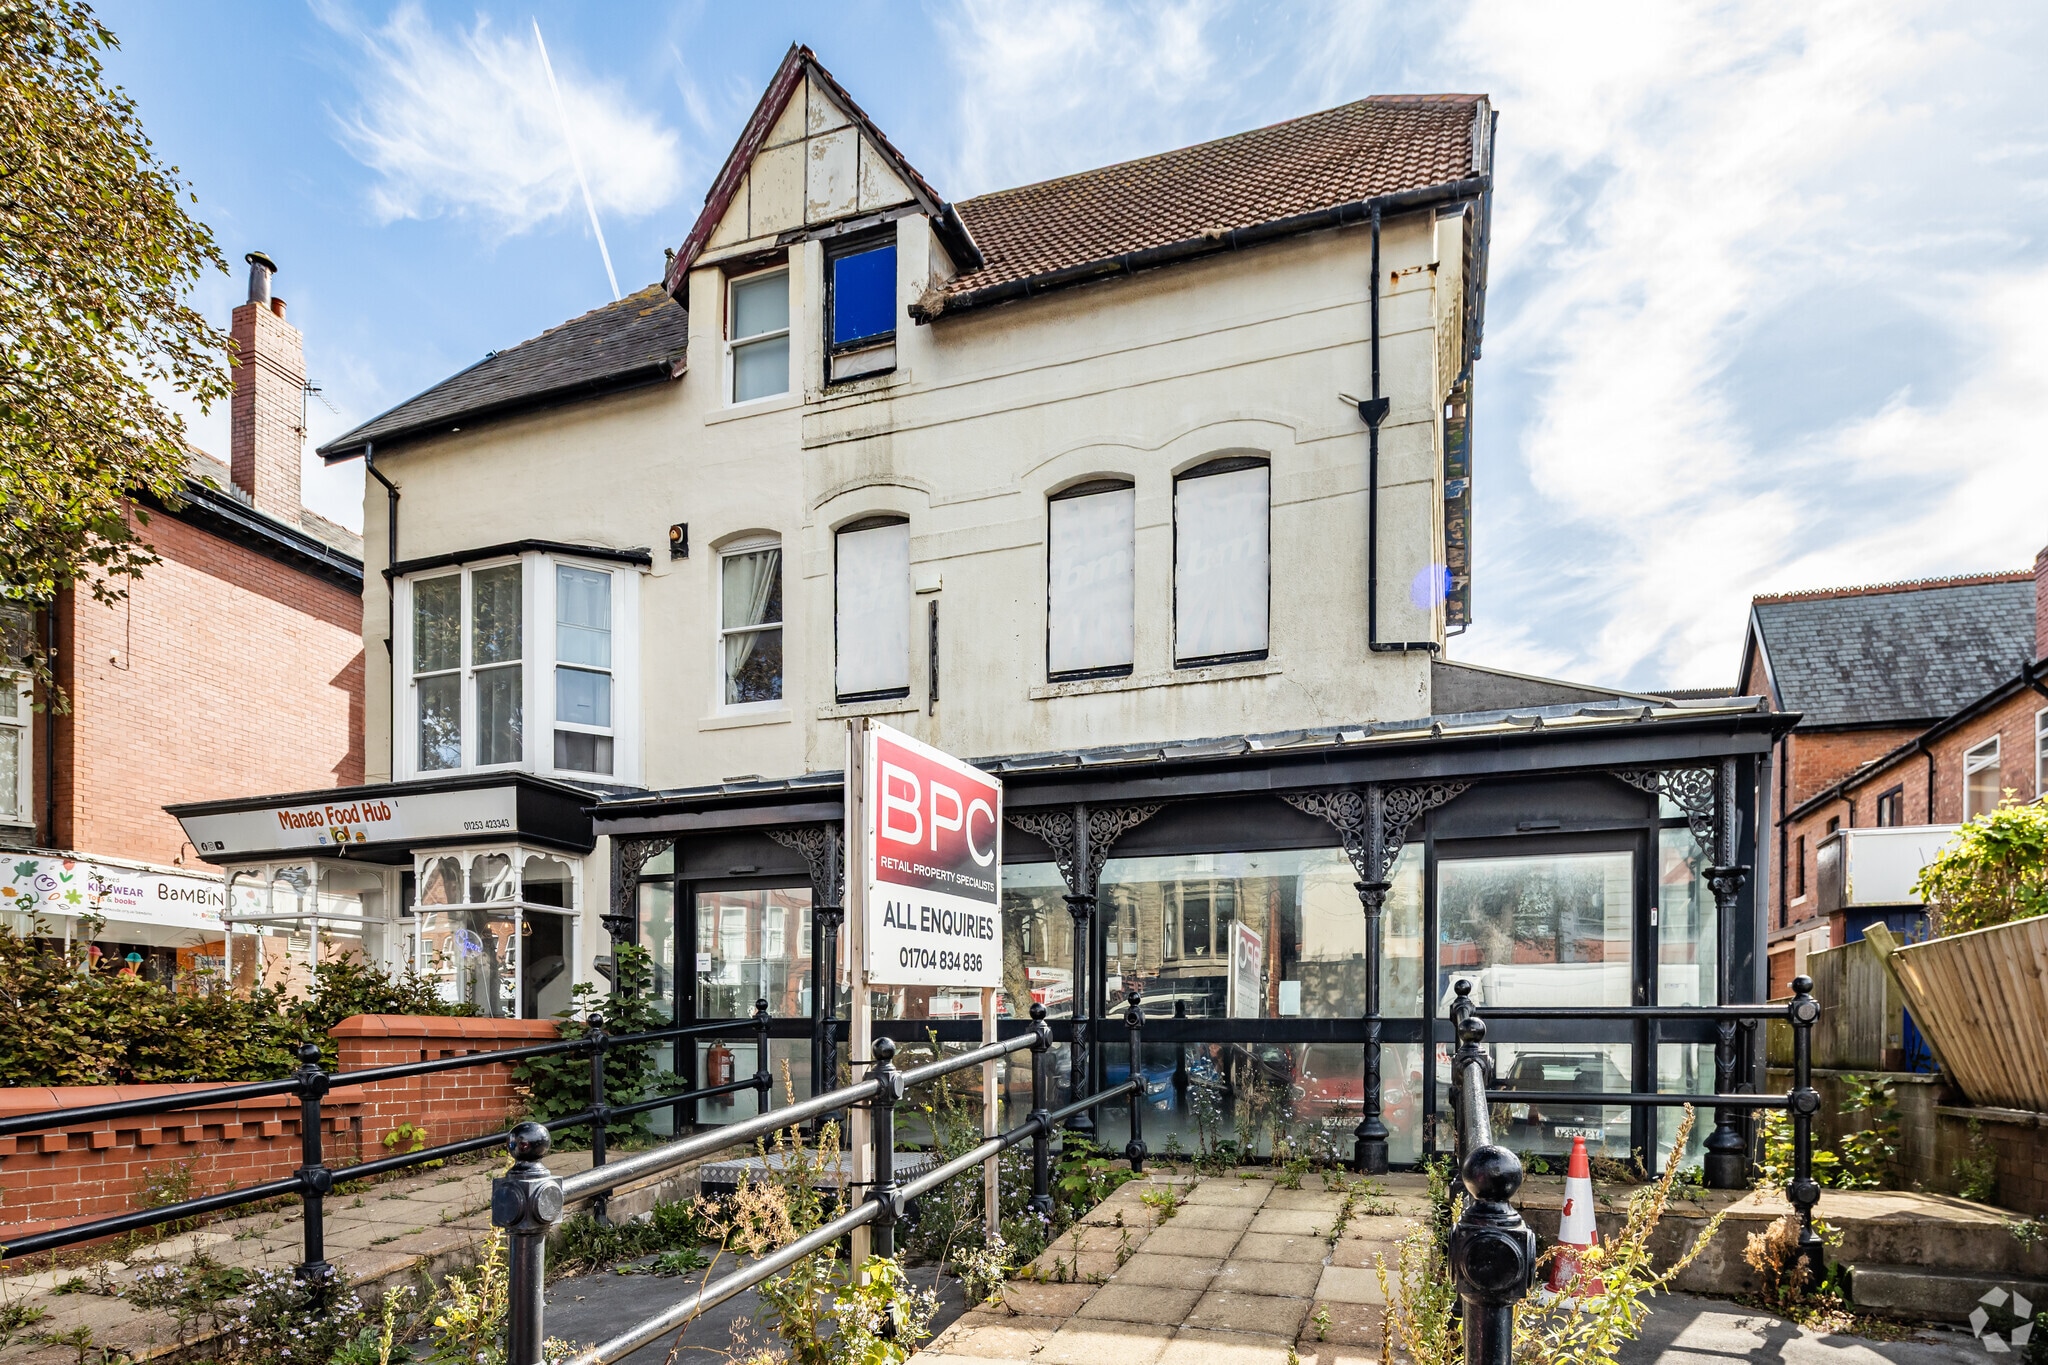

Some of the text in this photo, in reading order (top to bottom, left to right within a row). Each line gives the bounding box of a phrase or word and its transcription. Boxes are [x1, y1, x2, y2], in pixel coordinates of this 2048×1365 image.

[278, 801, 391, 830] Mango Food Hub
[463, 821, 483, 830] 01253
[881, 760, 995, 868] BPC
[880, 855, 995, 893] RETAIL PROPERTY SPECIALISTS
[88, 893, 105, 903] Tos
[114, 897, 137, 906] books
[883, 900, 994, 941] ALL ENQUIRIES
[900, 946, 983, 972] 01704 834 836
